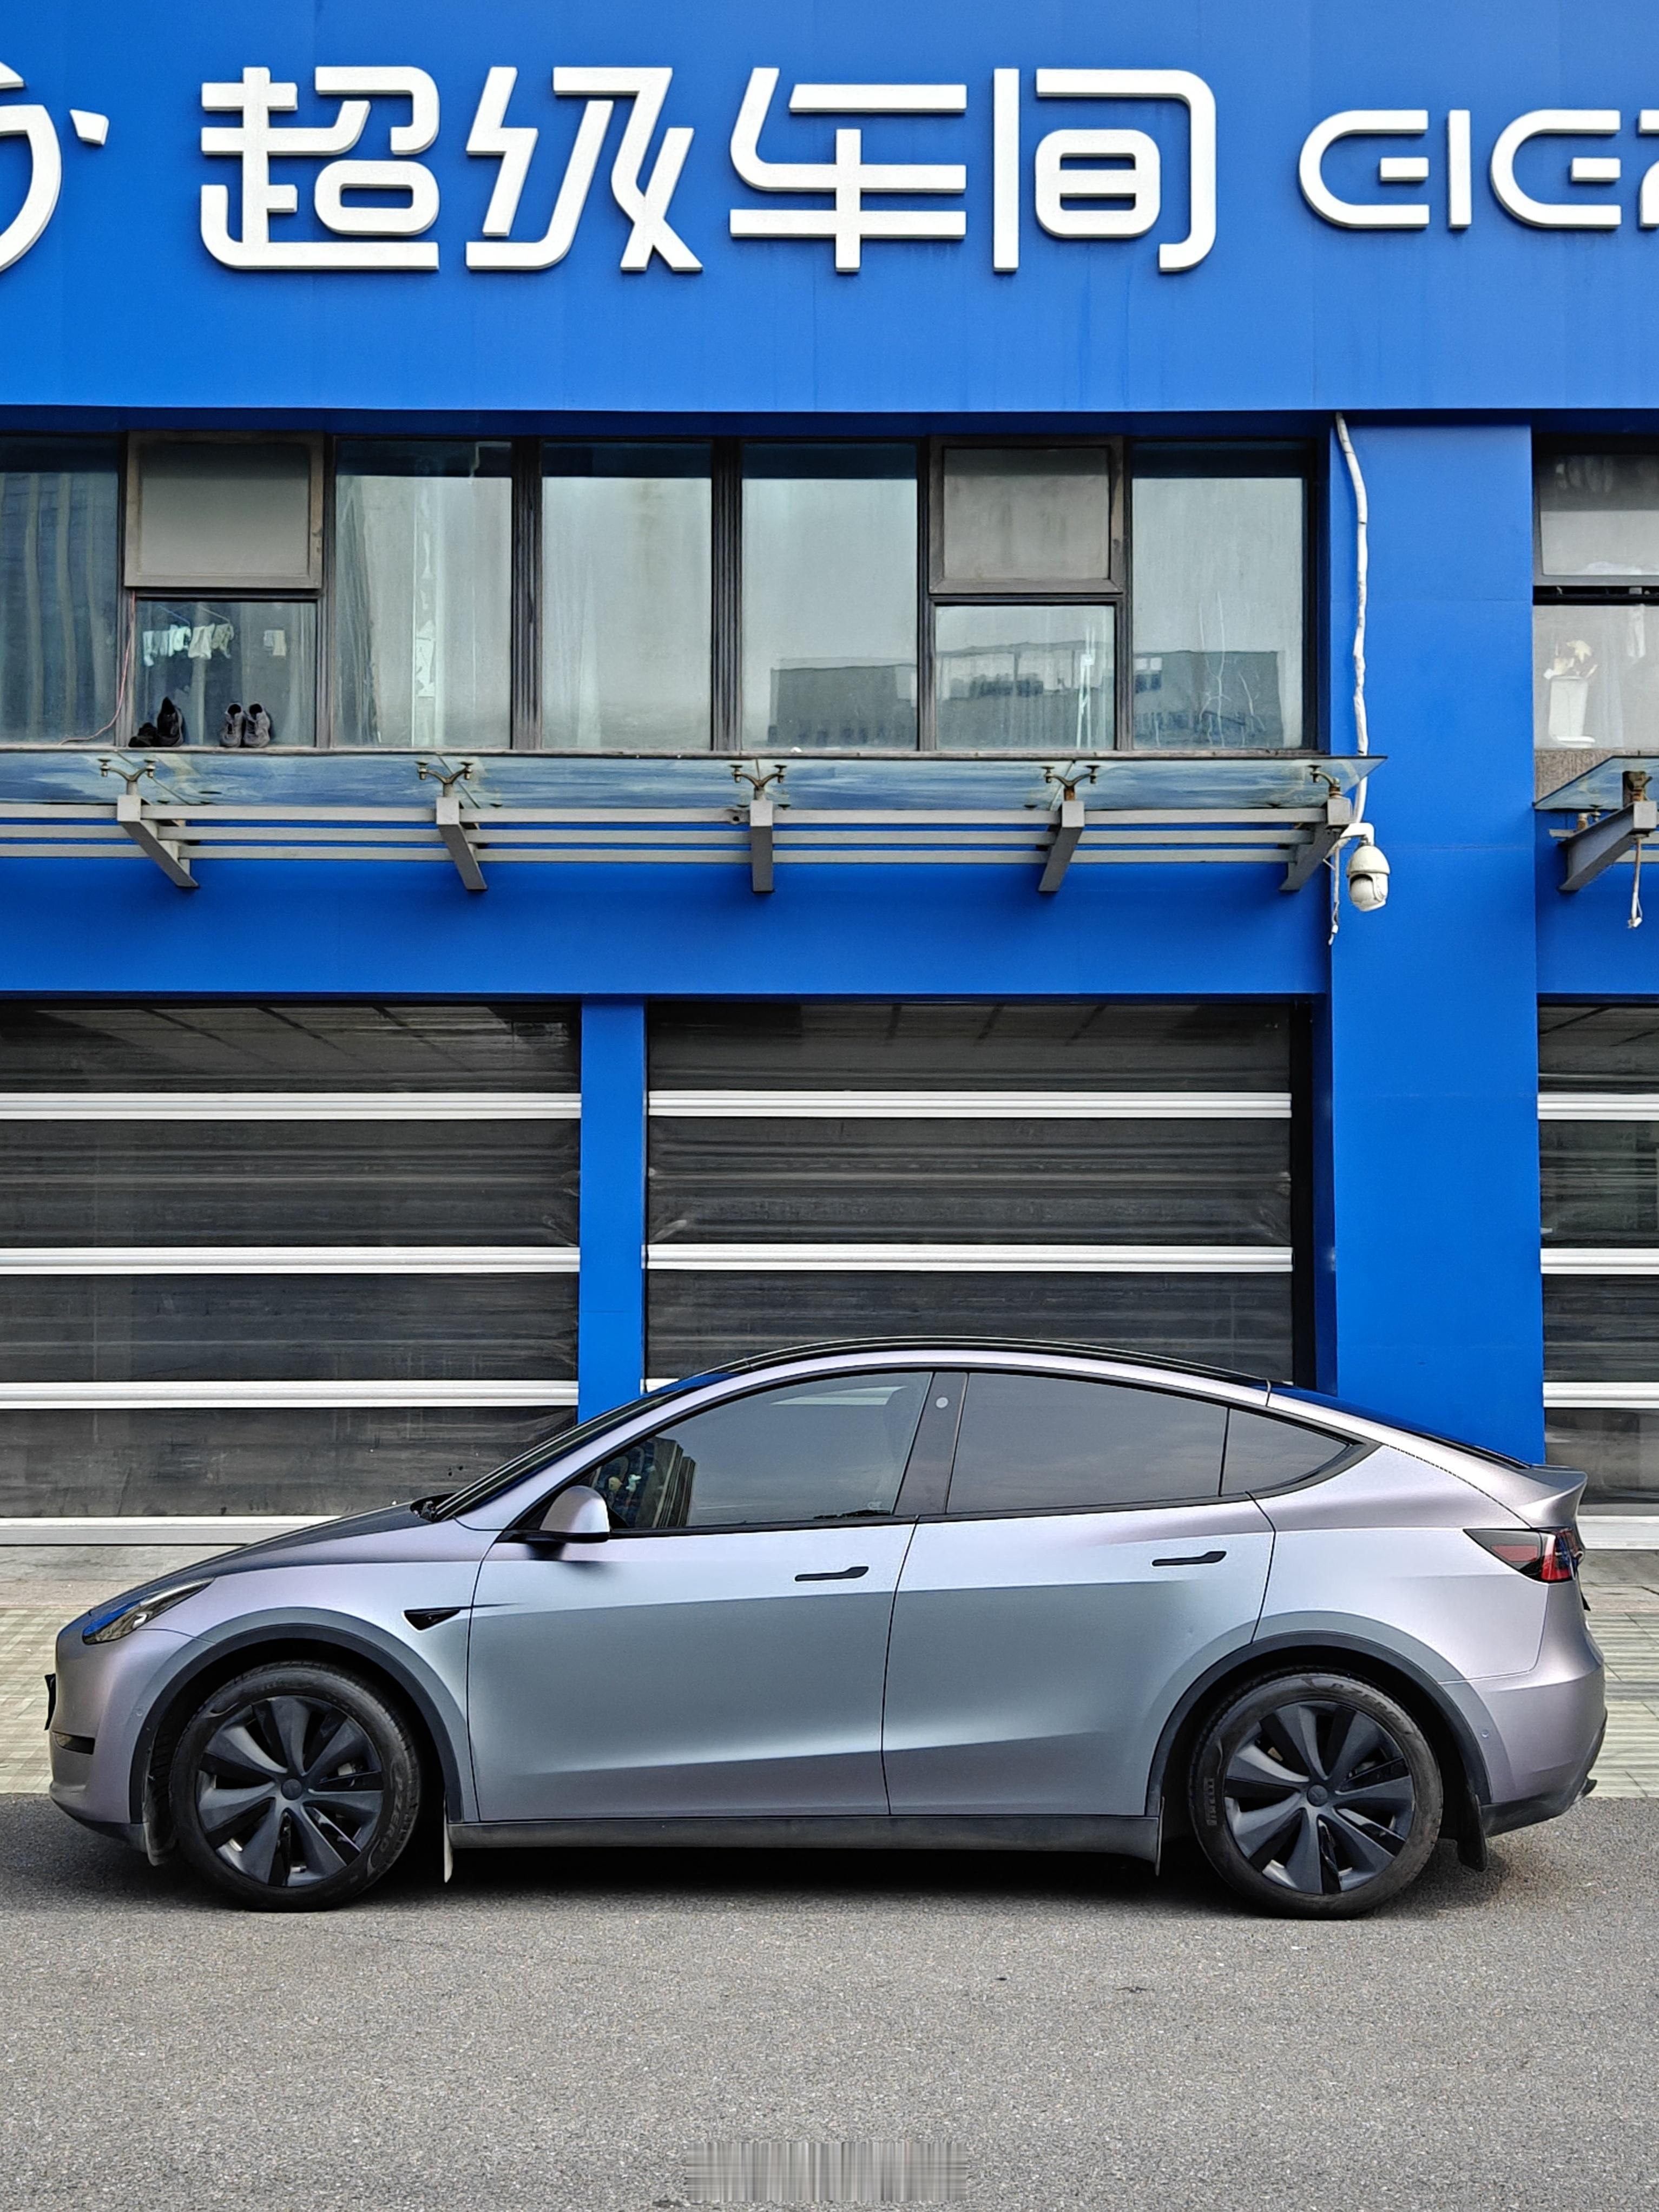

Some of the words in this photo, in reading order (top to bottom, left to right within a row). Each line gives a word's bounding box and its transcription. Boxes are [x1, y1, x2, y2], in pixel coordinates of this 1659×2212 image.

[200, 67, 1216, 271] 超级车间
[1299, 109, 1659, 228] GIG
